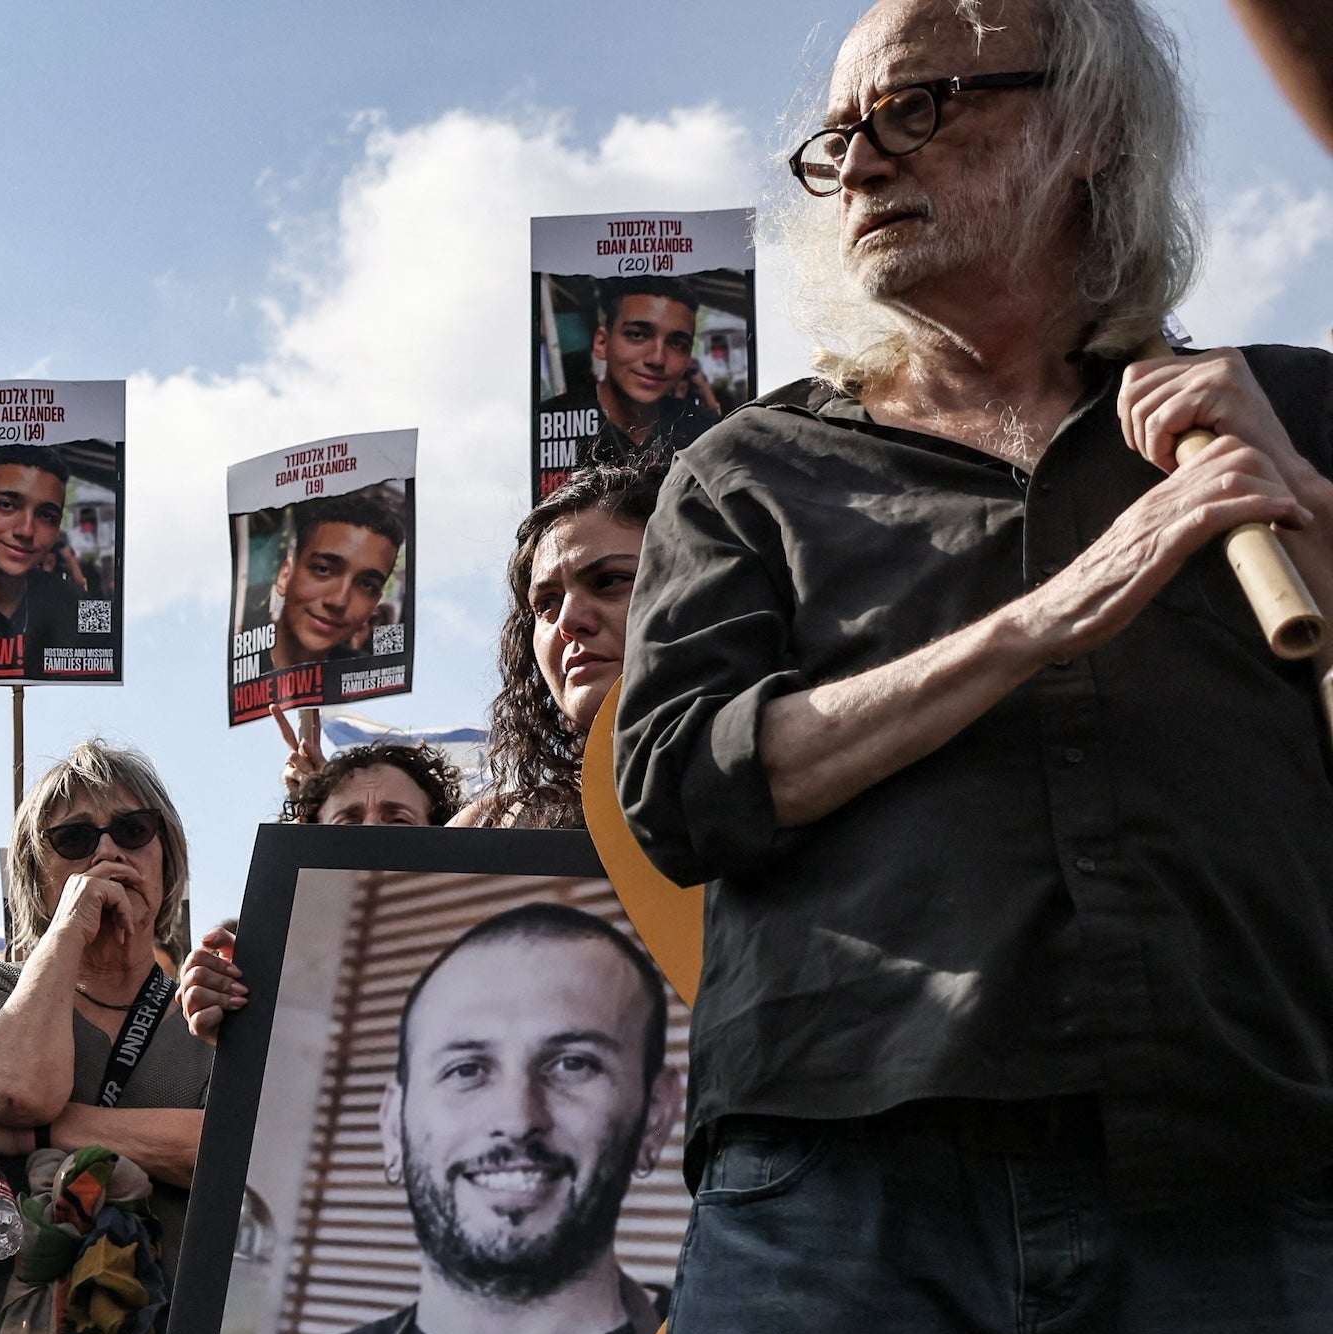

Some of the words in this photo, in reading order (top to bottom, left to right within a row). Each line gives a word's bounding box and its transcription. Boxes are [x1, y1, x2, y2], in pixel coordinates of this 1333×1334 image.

[607, 219, 656, 238] אלכסנדר
[659, 220, 681, 237] עידן
[597, 239, 626, 256] EDAN
[629, 237, 693, 254] ALEXANDER
[618, 256, 649, 274] (20)
[31, 388, 54, 406] עידן
[1, 406, 65, 422] ALEXANDER
[540, 408, 599, 440] BRING
[285, 447, 324, 468] אלכסנדר
[327, 442, 348, 461] עידן
[540, 440, 577, 469] HIM
[276, 468, 299, 487] EDAN
[301, 457, 357, 480] ALEXANDER
[305, 478, 324, 496] (19)
[233, 623, 276, 660] BRING
[43, 648, 73, 658] HOSTAGES
[87, 648, 113, 658] MISSING
[43, 657, 81, 671] FAMILIES
[83, 657, 113, 671] FORUM
[233, 653, 261, 685] HIM
[234, 678, 273, 712] HOME
[277, 664, 323, 700] NOW!
[341, 679, 376, 695] FAMILIES
[377, 673, 406, 689] FORUM
[116, 1004, 158, 1067] UNDER
